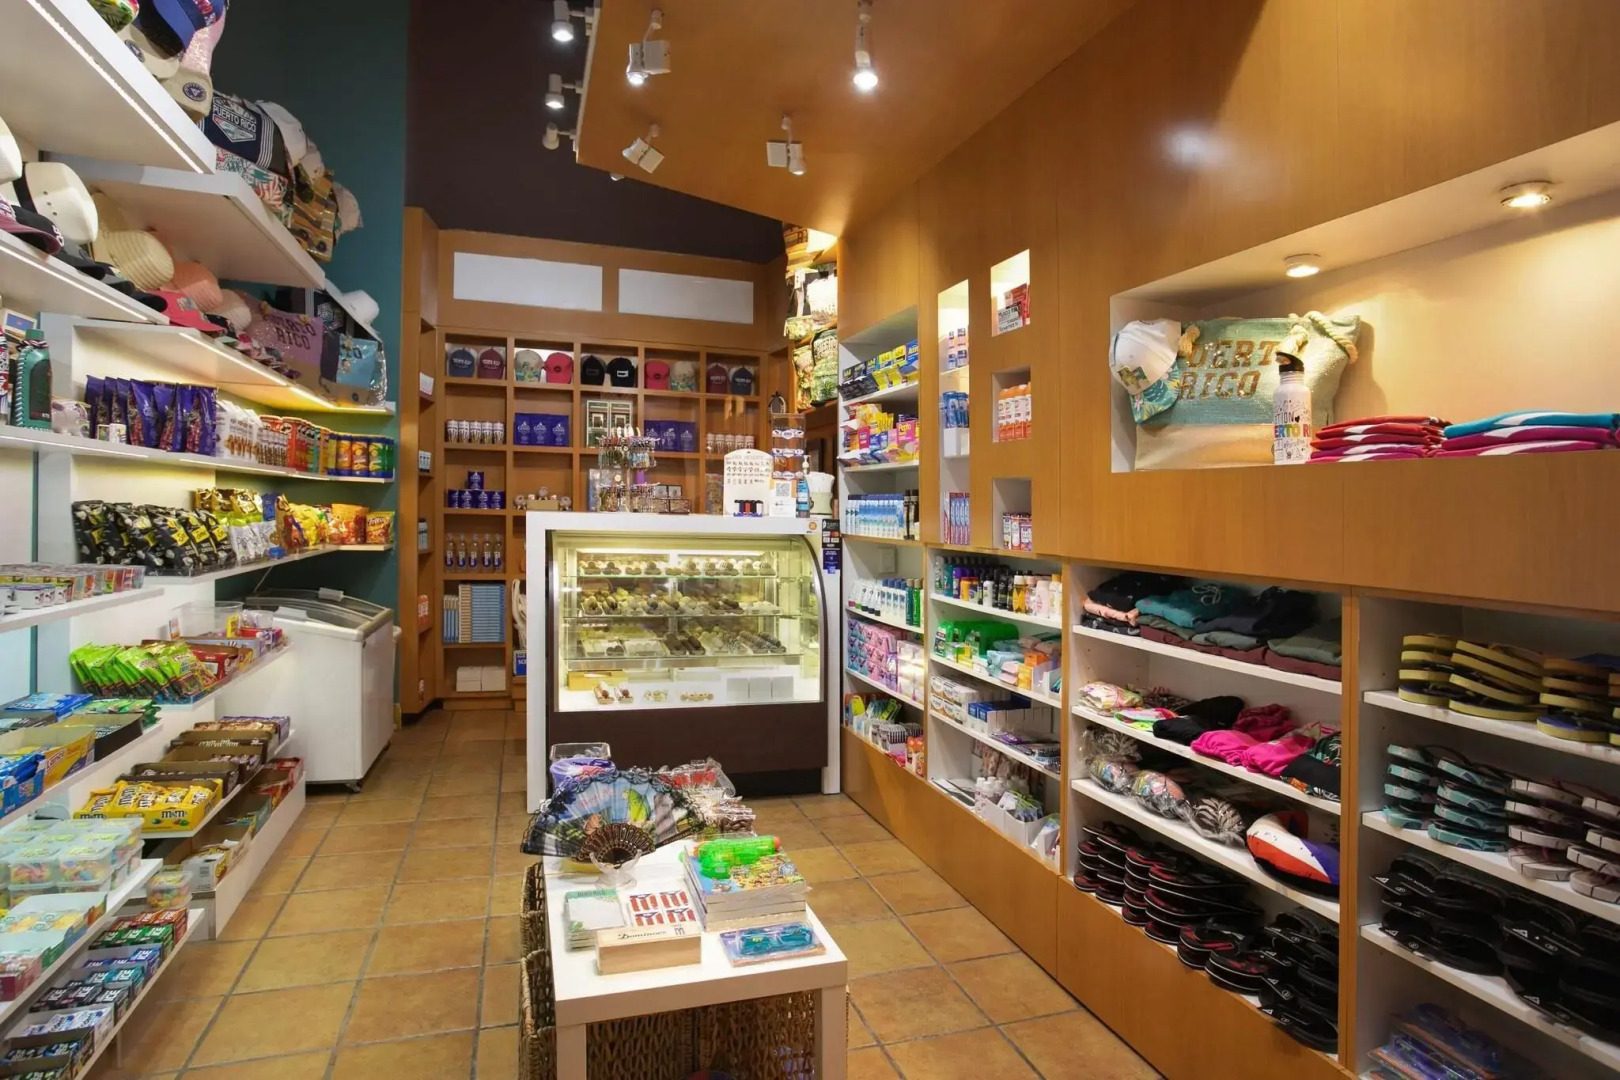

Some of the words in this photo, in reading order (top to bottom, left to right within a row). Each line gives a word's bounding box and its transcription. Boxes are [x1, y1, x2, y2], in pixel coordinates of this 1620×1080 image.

[213, 104, 241, 125] PUERTO
[241, 117, 256, 133] RICO
[277, 327, 311, 350] RICO
[1188, 340, 1281, 368] UERT
[1180, 371, 1261, 399] RICO
